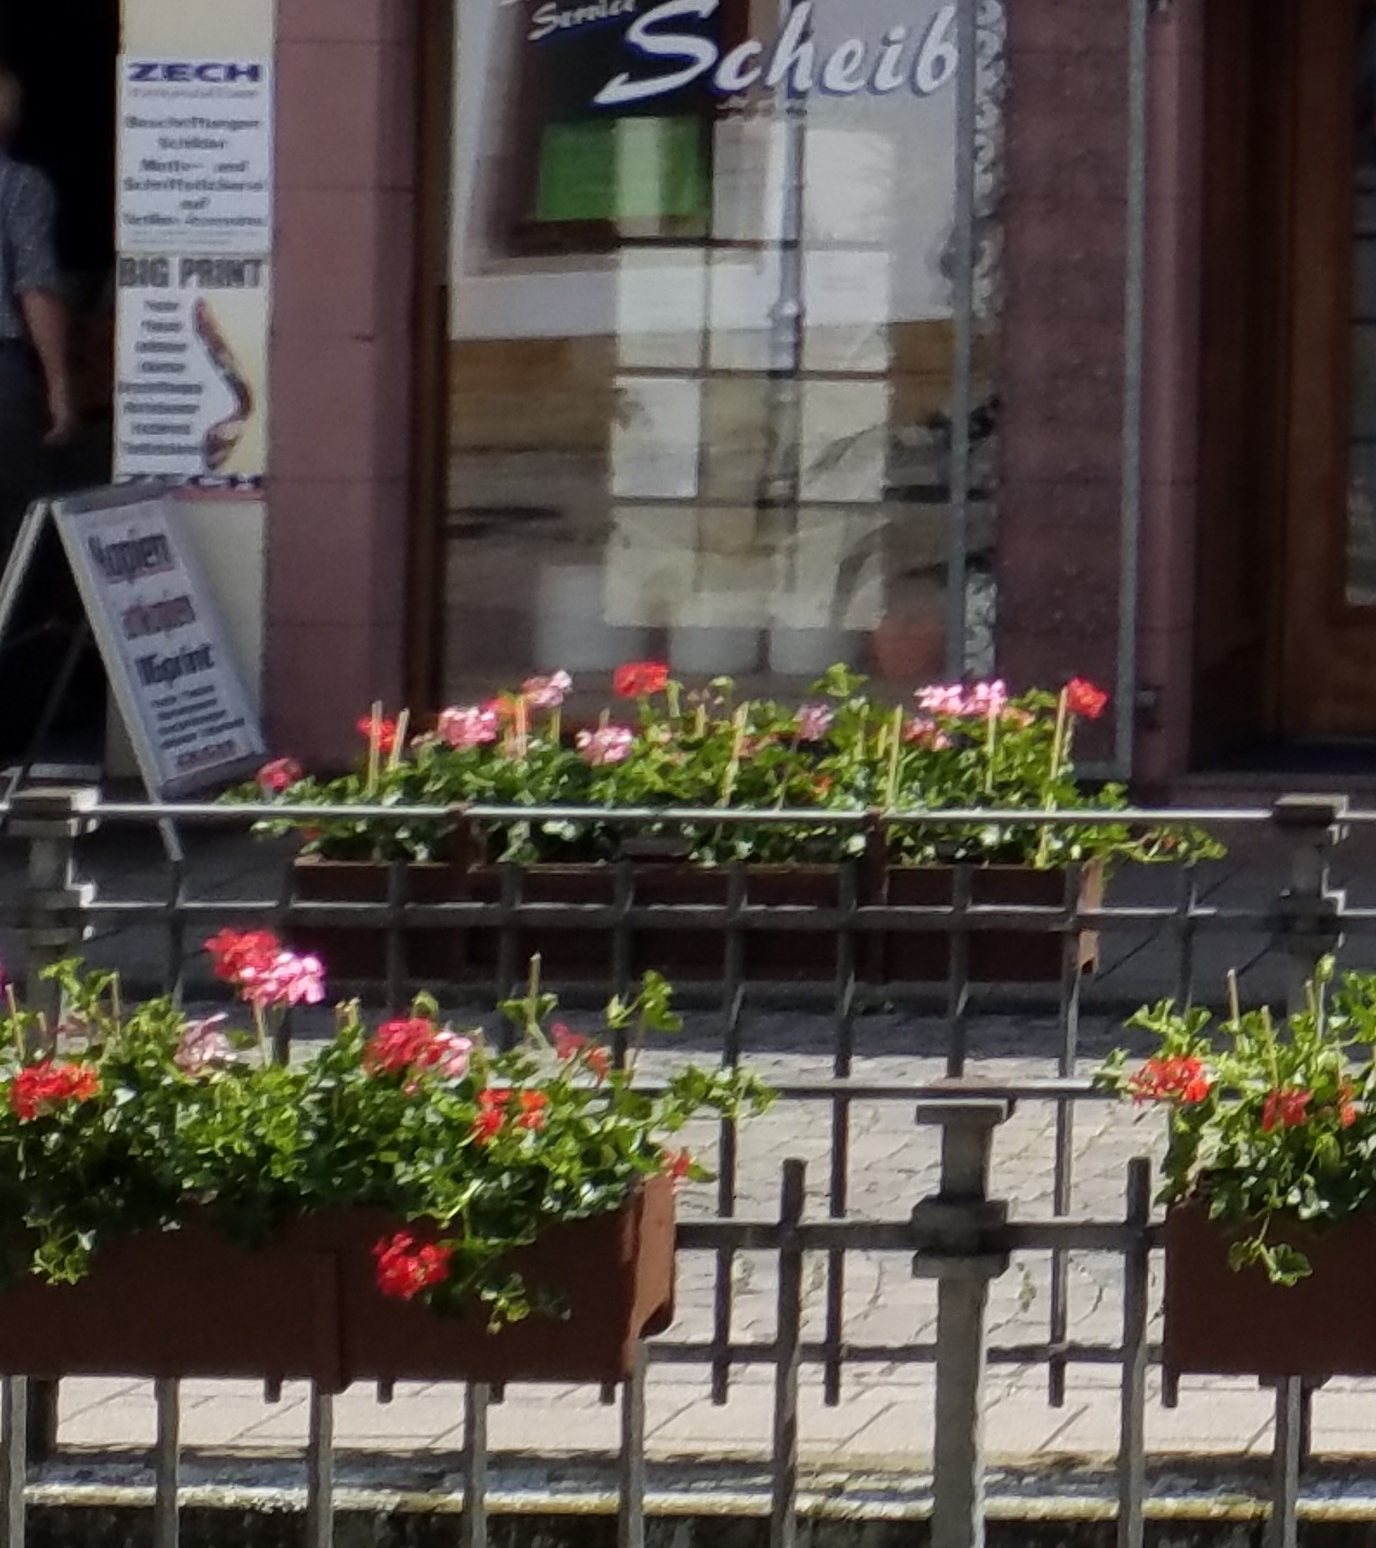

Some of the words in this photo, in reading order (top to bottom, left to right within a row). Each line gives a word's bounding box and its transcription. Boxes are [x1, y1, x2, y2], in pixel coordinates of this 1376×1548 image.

[128, 62, 261, 83] ZECH
[118, 259, 169, 288] BIG
[178, 259, 262, 289] PRINT
